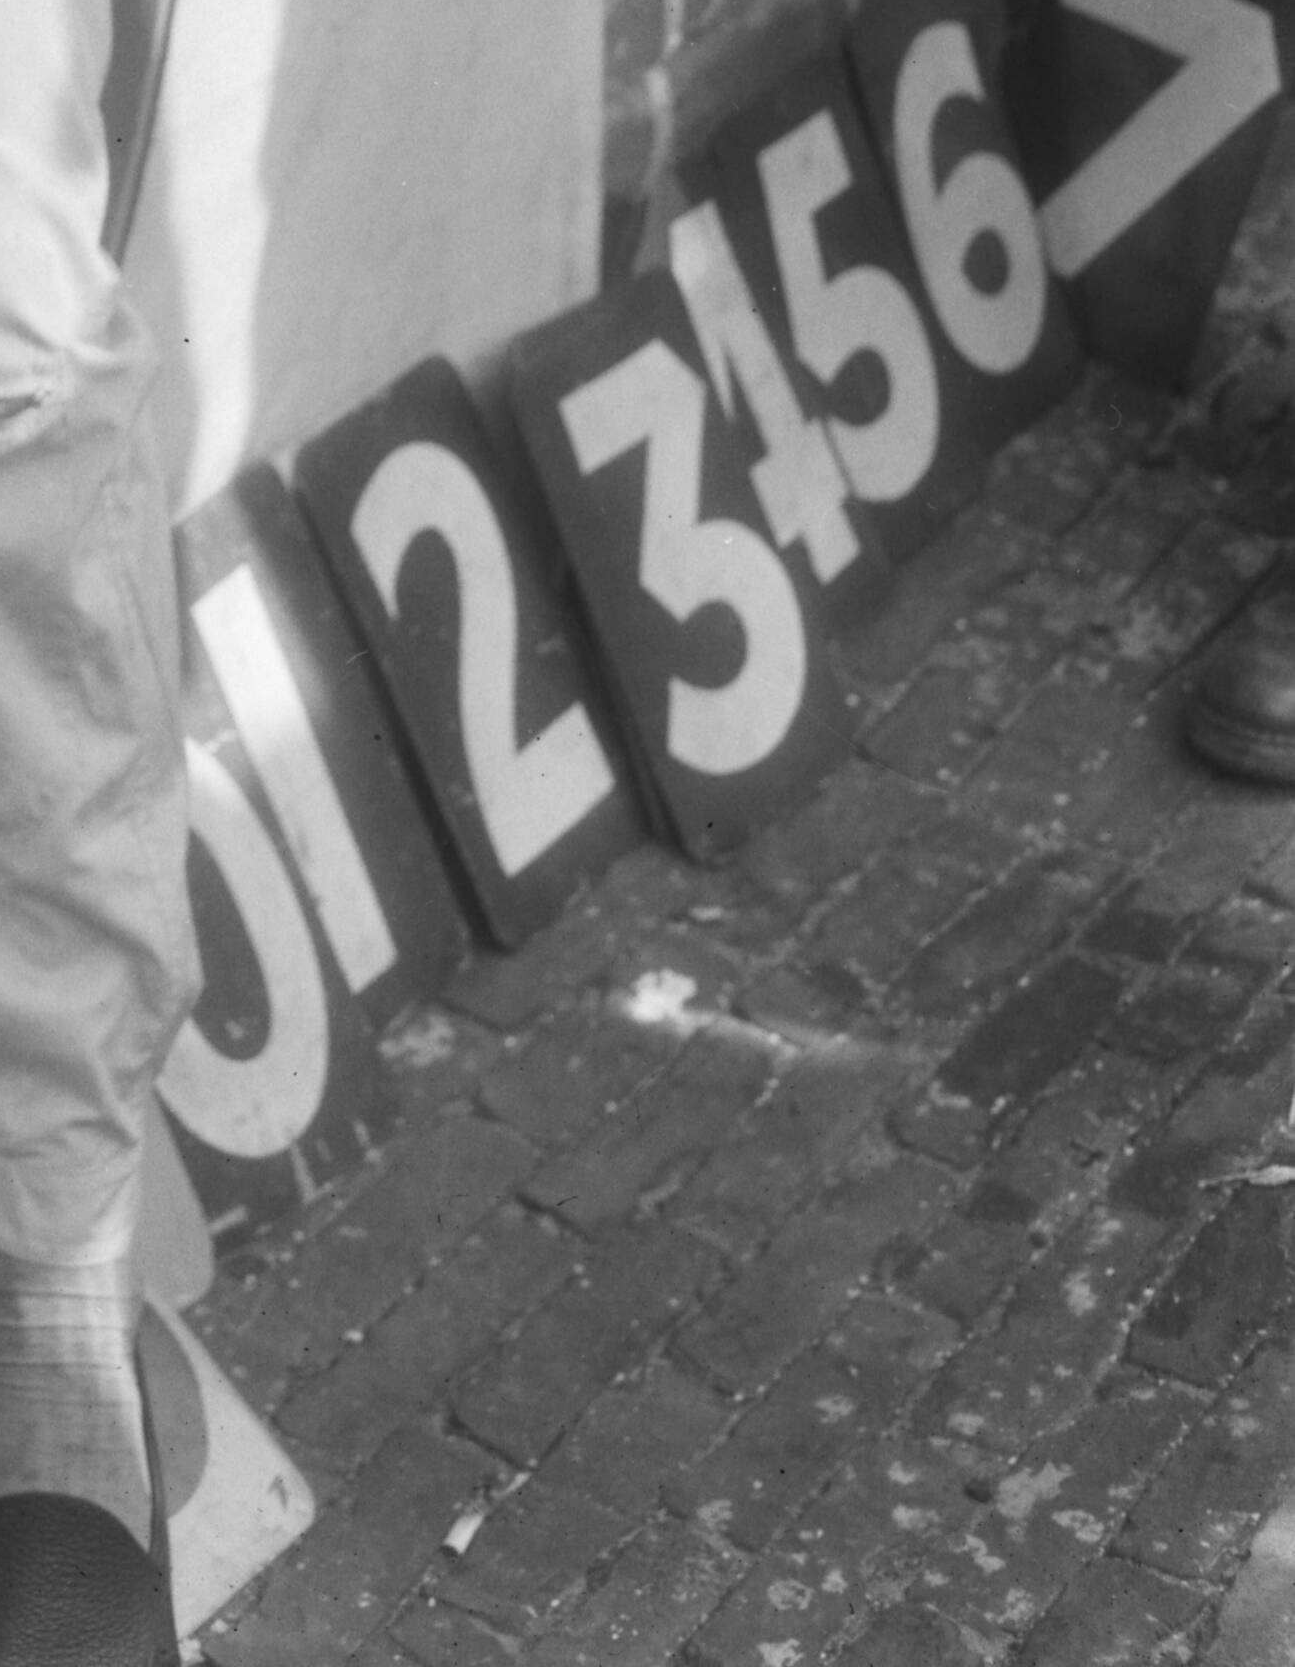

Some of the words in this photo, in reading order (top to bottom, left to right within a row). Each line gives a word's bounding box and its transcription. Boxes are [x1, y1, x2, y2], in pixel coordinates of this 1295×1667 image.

[757, 110, 940, 502] 5
[895, 22, 1047, 374] 6
[350, 442, 614, 876] 2
[559, 338, 806, 774] 3
[191, 563, 396, 993] 1
